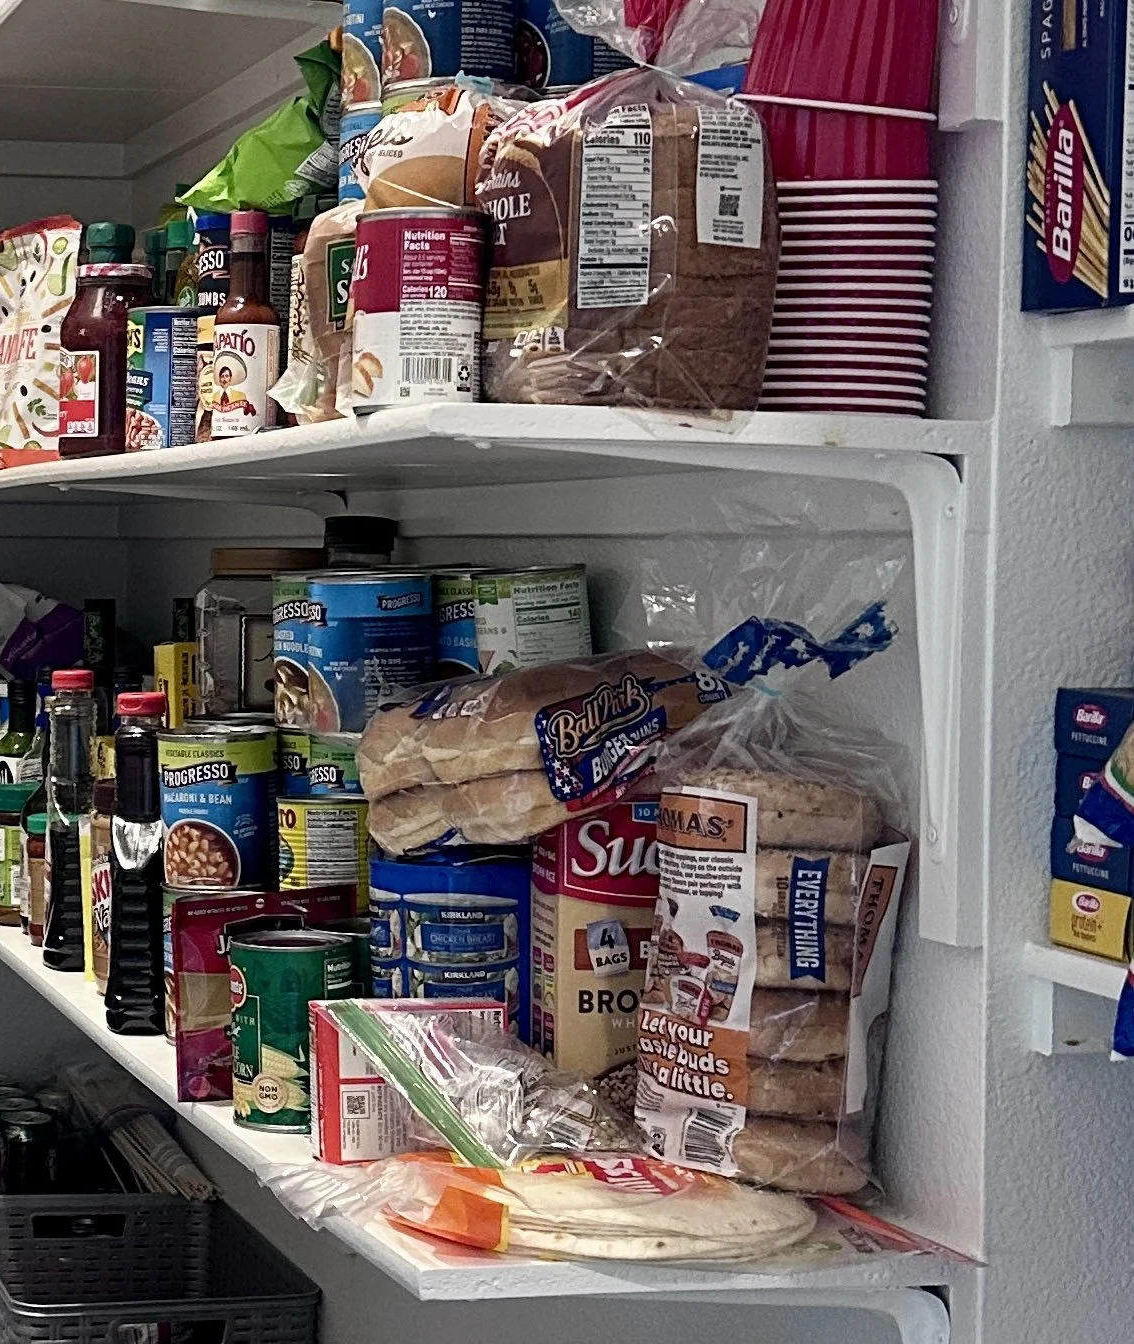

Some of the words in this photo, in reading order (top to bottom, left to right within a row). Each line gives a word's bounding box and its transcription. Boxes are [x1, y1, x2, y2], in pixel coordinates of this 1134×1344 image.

[634, 132, 650, 145] 110
[1052, 128, 1073, 261] Barilla
[404, 231, 446, 241] Nutrition
[404, 241, 430, 250] Facts
[428, 286, 448, 298] 120
[513, 585, 558, 595] Nutrition
[564, 581, 580, 590] Facts
[382, 595, 421, 610] PROGRESSO
[516, 615, 550, 623] Calories
[283, 642, 309, 653] NOODLE
[696, 671, 715, 692] 8
[1076, 709, 1105, 724] Barilla
[549, 699, 601, 754] Ball
[1071, 731, 1107, 746] FETTUCCINE
[193, 750, 224, 758] CLASSICS
[165, 763, 229, 787] PROGRESSO
[165, 794, 197, 803] MACARONI
[200, 794, 206, 803] &
[208, 794, 232, 805] BEAN
[639, 808, 650, 817] 10
[718, 865, 743, 873] outside
[1072, 862, 1109, 879] FETTUCCINE
[795, 869, 820, 968] EVERYTHING
[430, 934, 465, 944] CHICKEN
[468, 934, 496, 944] BREAST
[599, 928, 616, 950] 4
[595, 954, 628, 968] BAGS
[444, 970, 485, 979] KIRKLAND
[642, 1010, 666, 1034] Let
[667, 1020, 714, 1048] your
[259, 1085, 278, 1093] NON
[670, 1066, 735, 1102] little.
[259, 1093, 278, 1101] GMO
